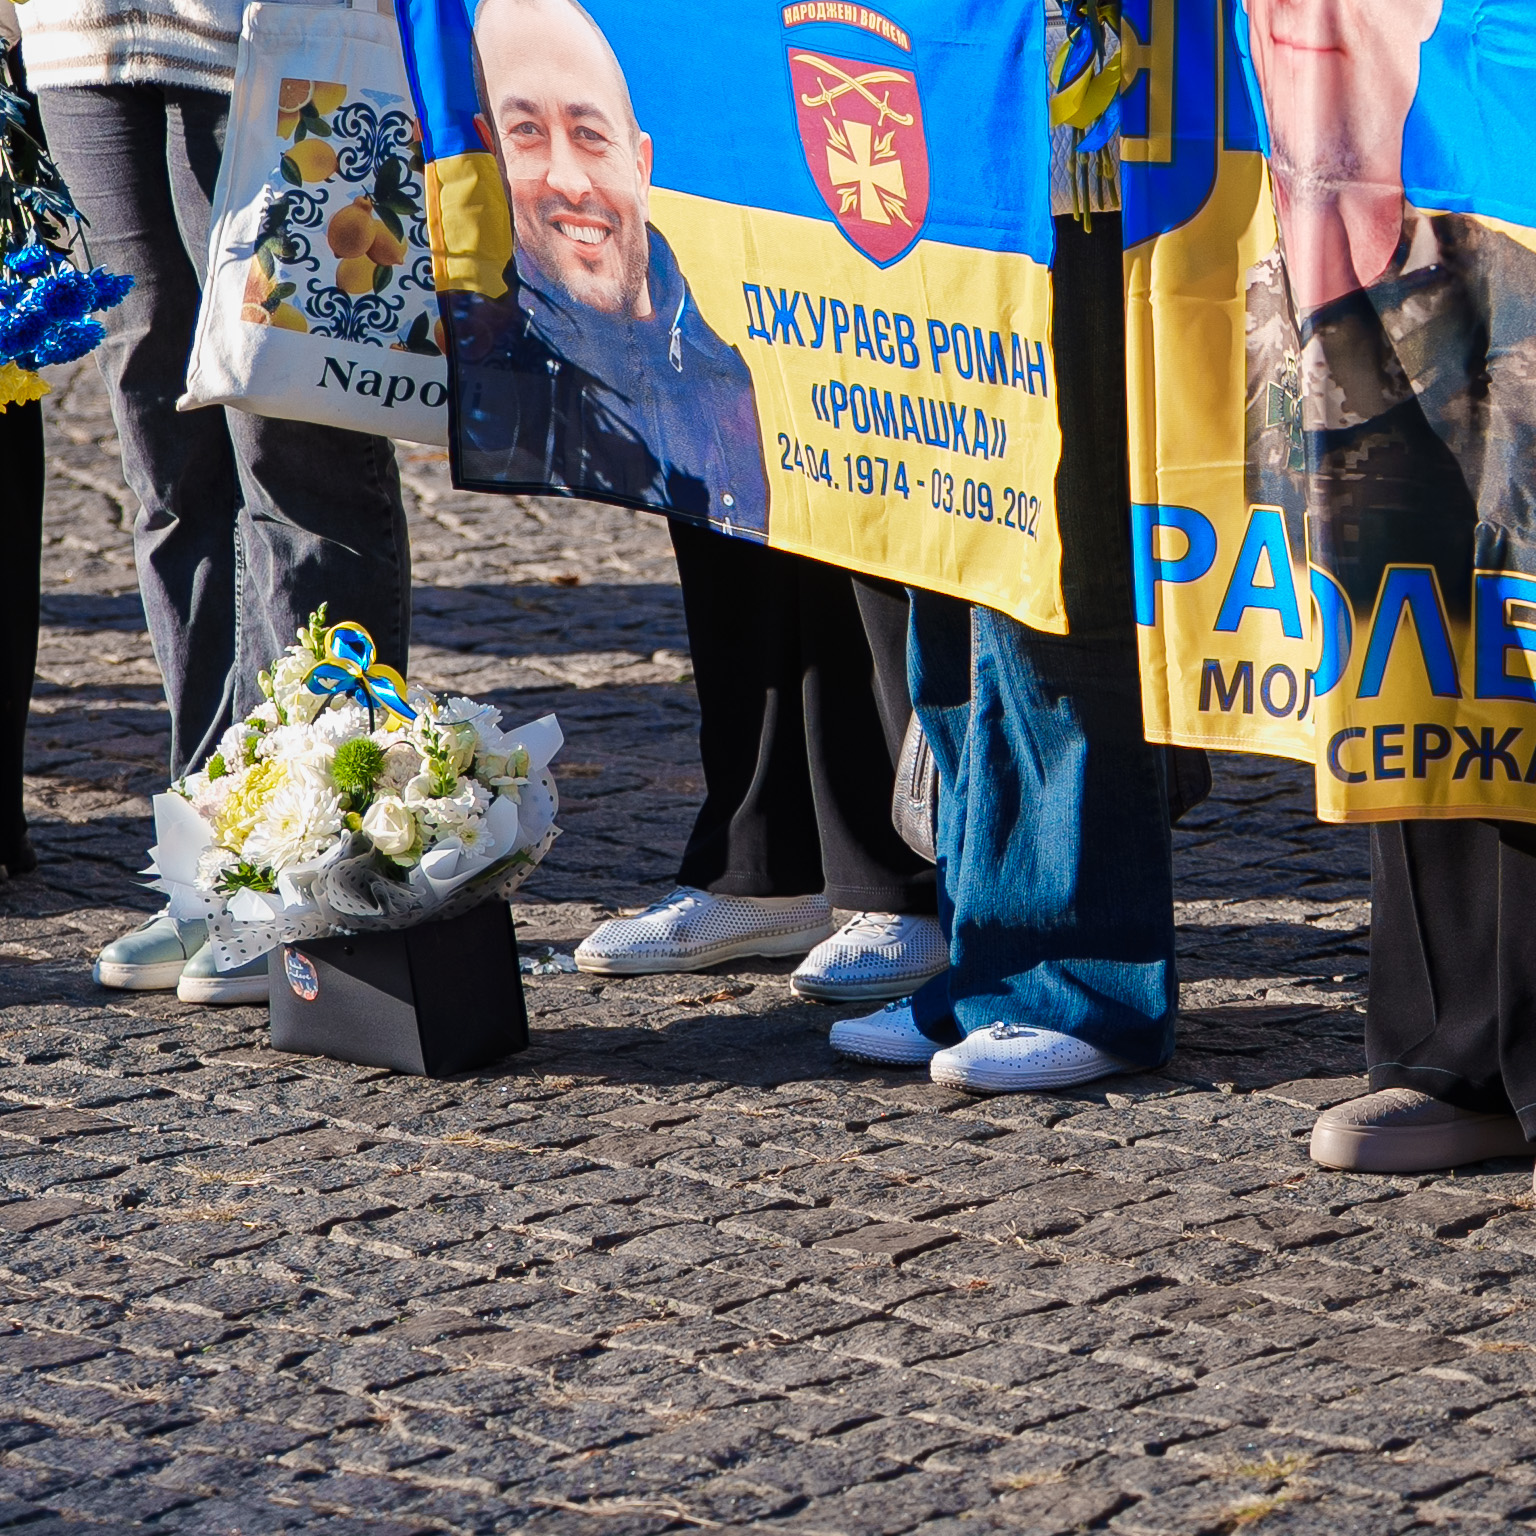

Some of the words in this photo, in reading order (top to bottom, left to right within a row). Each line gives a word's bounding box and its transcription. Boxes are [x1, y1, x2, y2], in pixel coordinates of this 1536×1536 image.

[783, 1, 858, 29] НАРОДЖЕНІ
[860, 7, 909, 50] ВОГНЕМ
[741, 281, 921, 370] ДЖУРАЄВ
[926, 317, 1049, 398] РОМАН
[811, 379, 1007, 461] «РОМАШКА»
[777, 432, 910, 500] 24.04.1974
[931, 468, 1042, 543] 03.09.202
